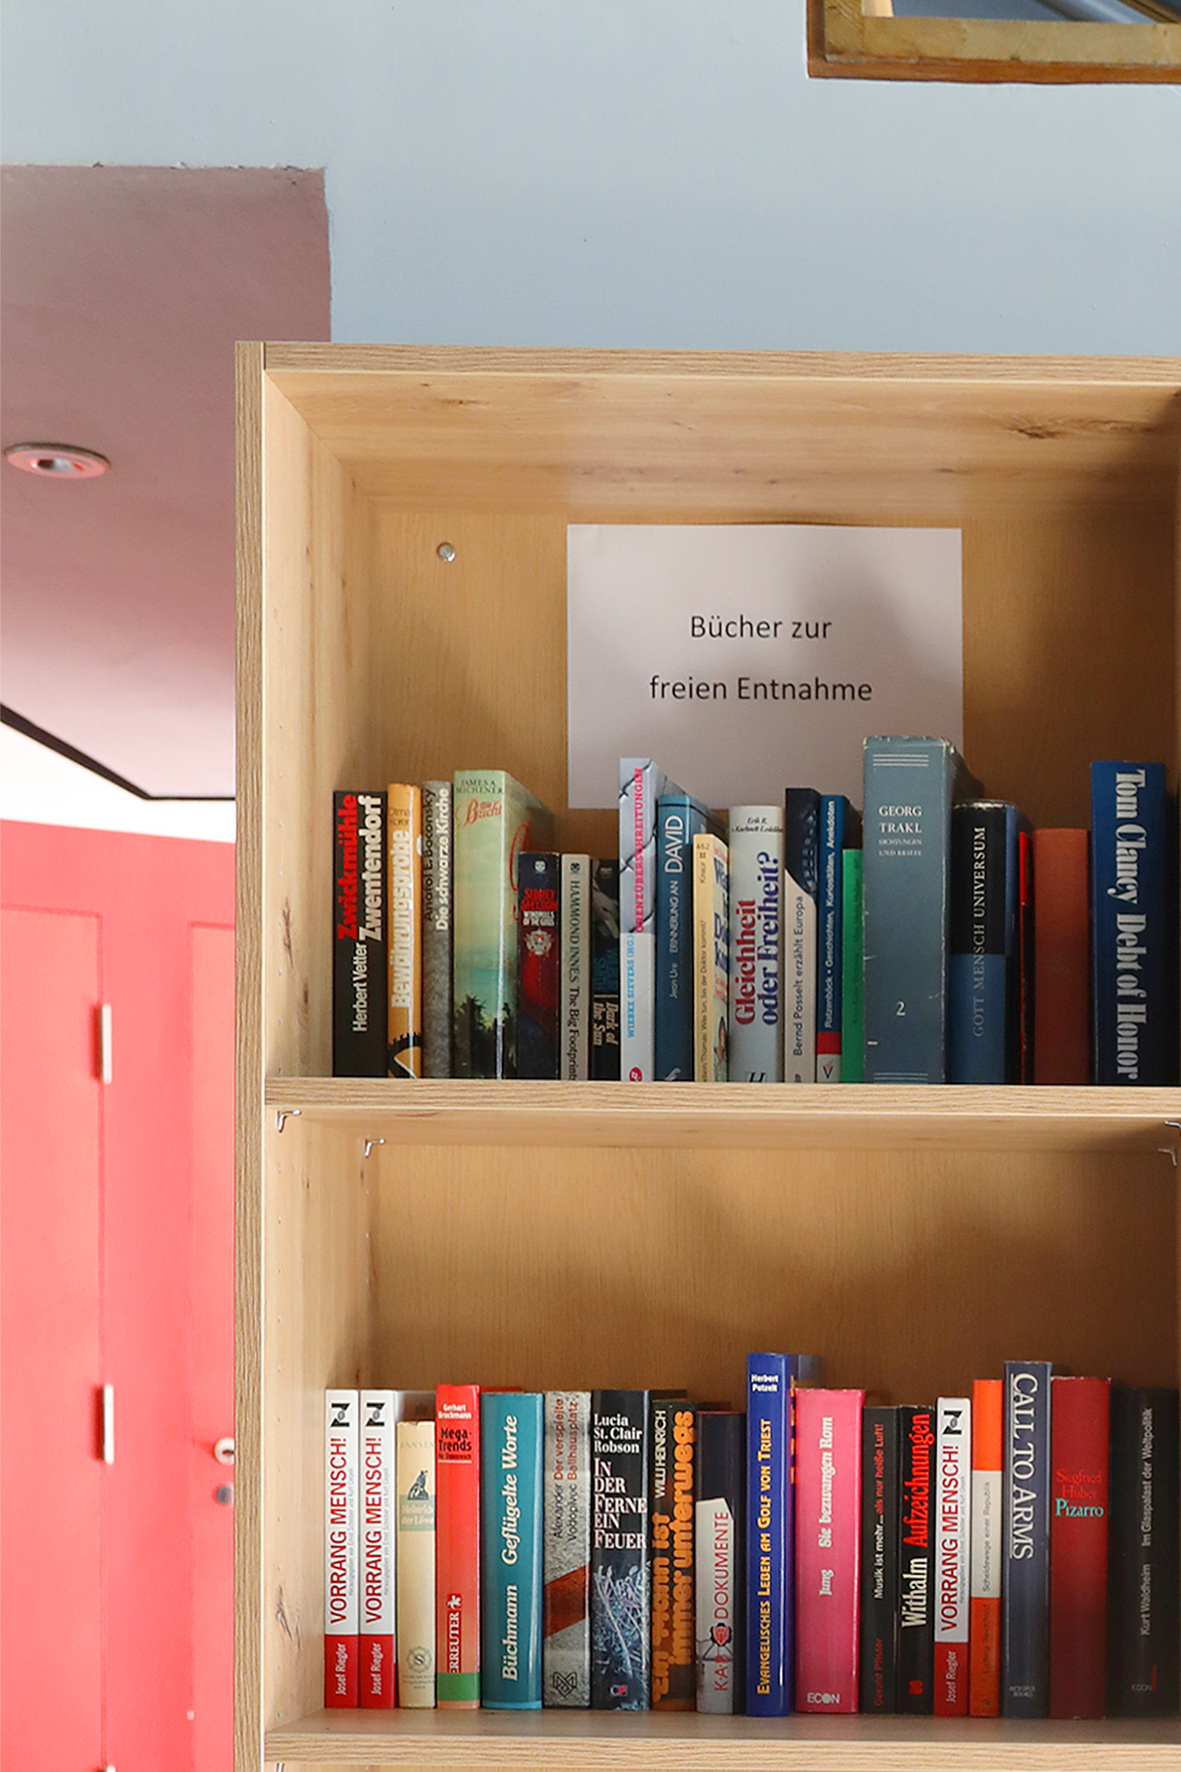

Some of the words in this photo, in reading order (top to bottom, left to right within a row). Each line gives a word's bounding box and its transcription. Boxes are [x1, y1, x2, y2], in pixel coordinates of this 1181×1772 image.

[691, 615, 783, 638] Bücher
[792, 620, 832, 639] zur
[650, 675, 727, 700] freien
[738, 677, 872, 701] Entnahme
[436, 789, 448, 842] Kirche
[879, 806, 922, 817] GEORG
[1115, 770, 1146, 818] Tom
[665, 815, 684, 873] DAVID
[879, 823, 921, 833] TRAKL
[338, 794, 357, 940] Zwickmühle
[358, 795, 382, 941] Zwentendorf
[436, 846, 448, 910] schwarze
[974, 826, 985, 917] UNIVERSUM
[1107, 824, 1147, 905] Clancy
[391, 829, 410, 1008] Bewährungsprobe
[436, 911, 448, 930] Die
[570, 880, 580, 946] HAMMOND
[757, 852, 778, 974] Freiheit?
[794, 896, 805, 936] Europa
[353, 943, 367, 979] Vetter
[570, 947, 580, 982] INNES
[736, 900, 756, 1025] Gleichheit
[794, 939, 803, 979] erzählt
[974, 924, 985, 990] MENSCH
[1115, 915, 1146, 970] Debt
[353, 981, 367, 1031] Herbert
[758, 977, 778, 1025] oder
[795, 982, 804, 1022] Posselt
[896, 1001, 906, 1016] 2
[1116, 974, 1146, 998] of
[795, 1025, 803, 1056] Bernd
[974, 994, 984, 1037] GOTT
[1116, 1004, 1146, 1080] Honor
[594, 1414, 629, 1427] Lucia
[1010, 1371, 1038, 1439] CALL
[439, 1440, 471, 1452] Trends
[502, 1415, 518, 1470] Worte
[594, 1428, 608, 1439] St.
[611, 1428, 643, 1440] Clair
[594, 1442, 639, 1453] Robson
[820, 1417, 832, 1449] Rom
[331, 1437, 347, 1524] MENSCH!
[366, 1437, 381, 1524] MENSCH!
[594, 1458, 611, 1476] IN
[594, 1477, 626, 1494] DER
[670, 1410, 696, 1568] unterwegs
[819, 1452, 835, 1521] bezwangen
[903, 1413, 934, 1548] Aufzeichnungen
[941, 1445, 959, 1534] MENSCH!
[1012, 1450, 1036, 1478] TO
[502, 1474, 521, 1565] Geflügelte
[594, 1495, 647, 1512] FERNE
[594, 1513, 619, 1529] EIN
[1011, 1487, 1037, 1559] ARMS
[1056, 1499, 1104, 1517] Pizarro
[594, 1531, 647, 1549] FEUER
[819, 1523, 831, 1548] Sie
[331, 1531, 347, 1623] VORRANG
[366, 1531, 381, 1623] VORRANG
[714, 1512, 728, 1619] DOKUMENTE
[819, 1569, 833, 1595] Jung
[941, 1539, 958, 1631] VORRANG
[669, 1569, 691, 1665] immer
[902, 1557, 927, 1627] Withalm
[502, 1585, 518, 1681] Büchmann
